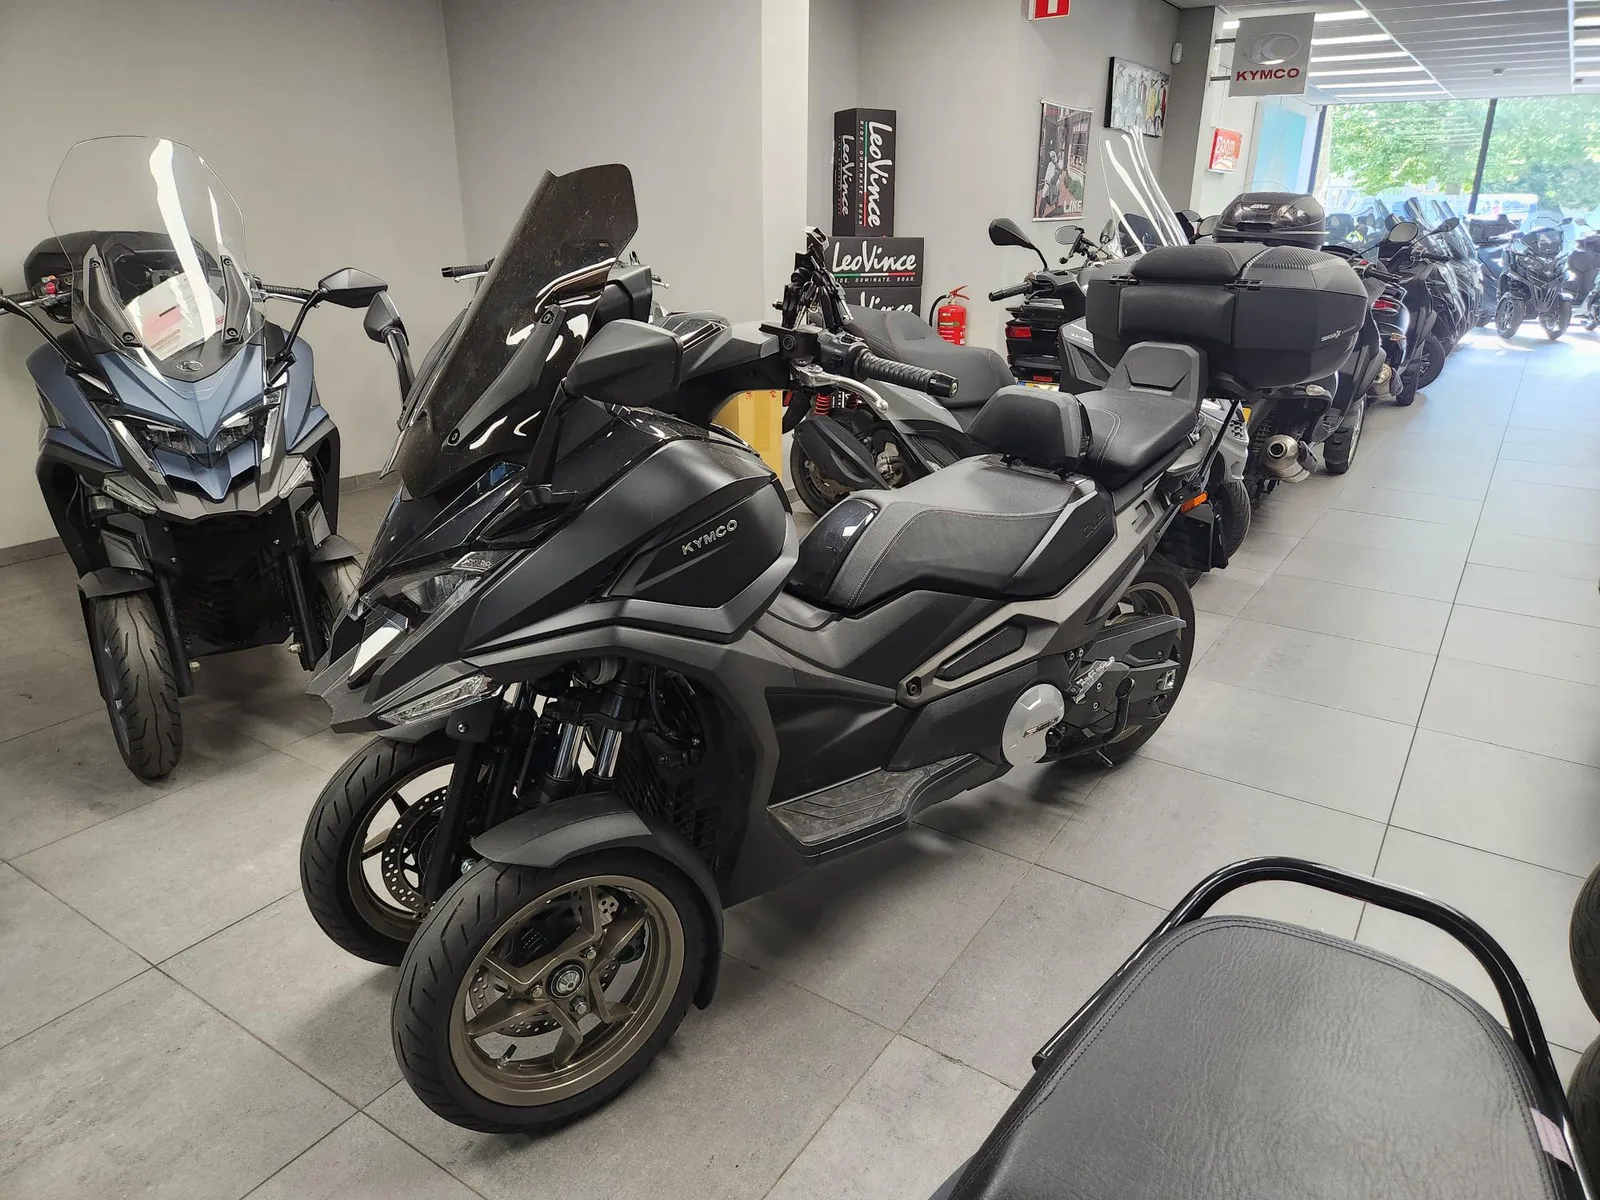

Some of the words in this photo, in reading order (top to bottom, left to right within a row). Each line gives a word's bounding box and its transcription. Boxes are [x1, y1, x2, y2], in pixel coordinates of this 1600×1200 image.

[1235, 67, 1300, 82] KYMCO
[842, 134, 855, 217] LeoVince
[868, 121, 893, 228] LeoVince
[832, 240, 917, 272] LeoVince
[681, 519, 738, 556] KYMCO
